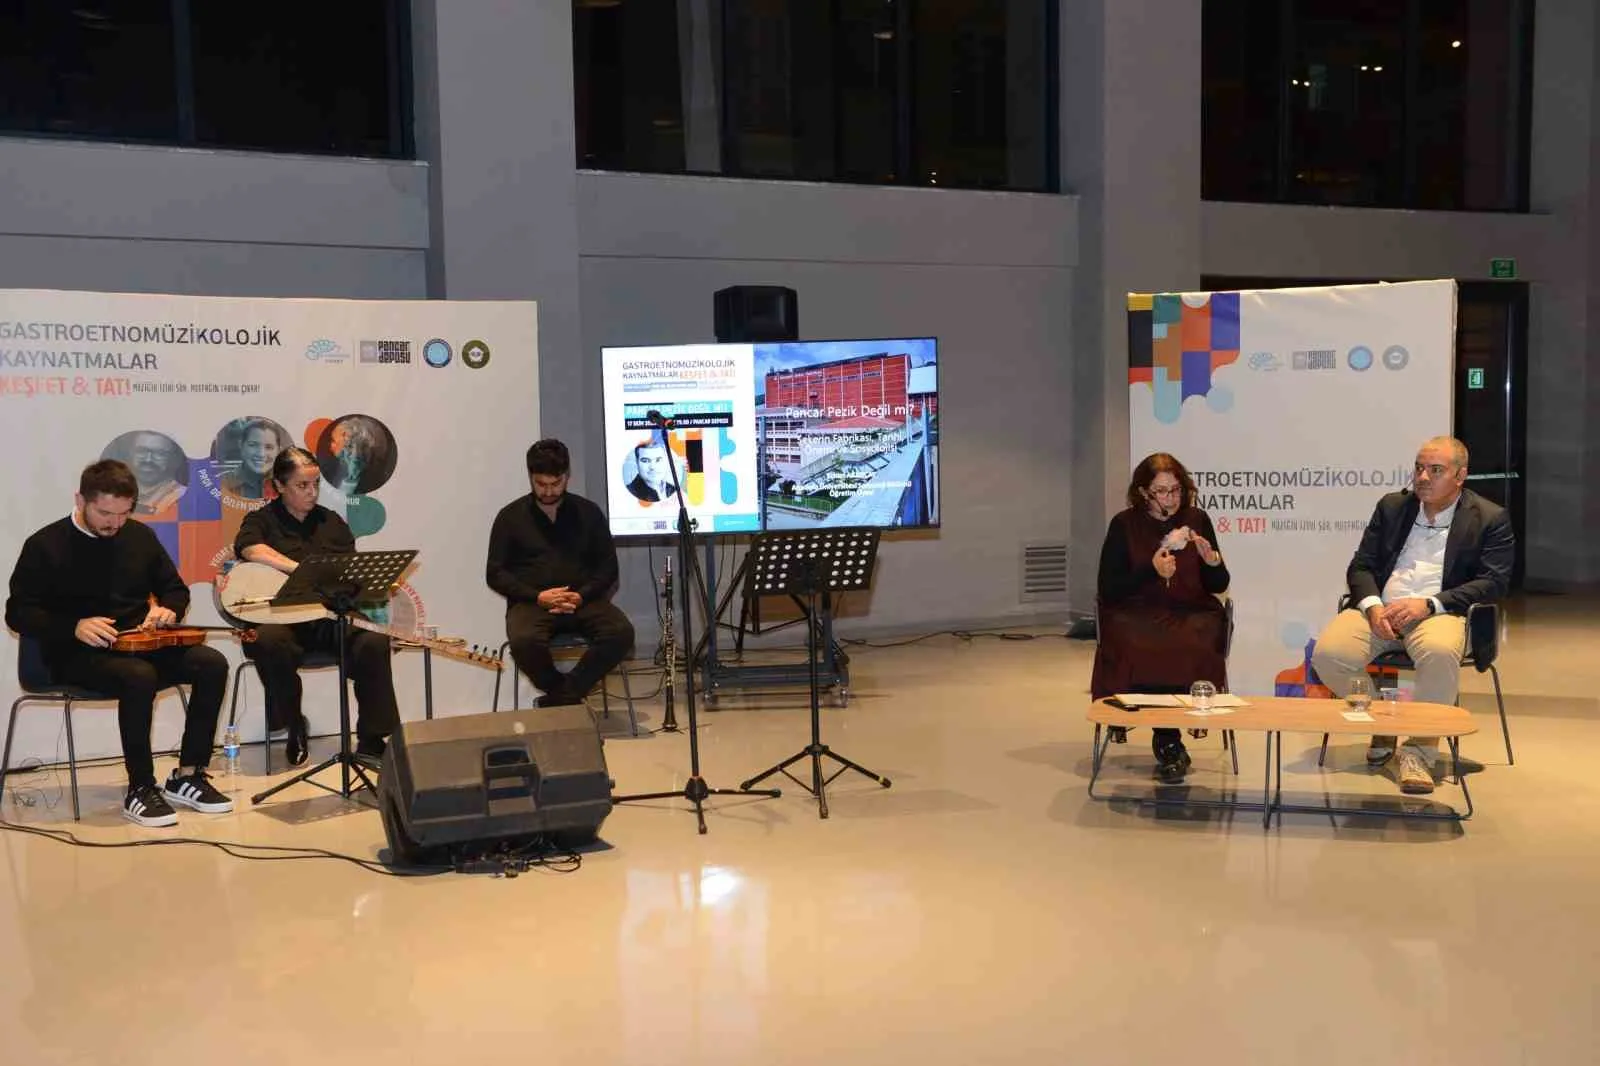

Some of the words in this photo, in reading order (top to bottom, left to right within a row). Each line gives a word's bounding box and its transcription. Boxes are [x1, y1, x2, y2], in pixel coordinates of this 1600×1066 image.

[0, 321, 281, 346] GASTROETNOMÜZİKOLOJİK
[0, 350, 158, 370] KAYNATMALAR
[72, 376, 91, 395] &
[95, 377, 131, 396] TAT!
[785, 407, 826, 418] Pancar
[827, 406, 857, 417] Pezik
[861, 404, 891, 419] Değil
[1187, 465, 1414, 487] TROETNOMÜZİKOLOJİK
[1196, 493, 1295, 511] NATMALAR
[1216, 516, 1232, 534] &
[1236, 517, 1266, 534] TAT!
